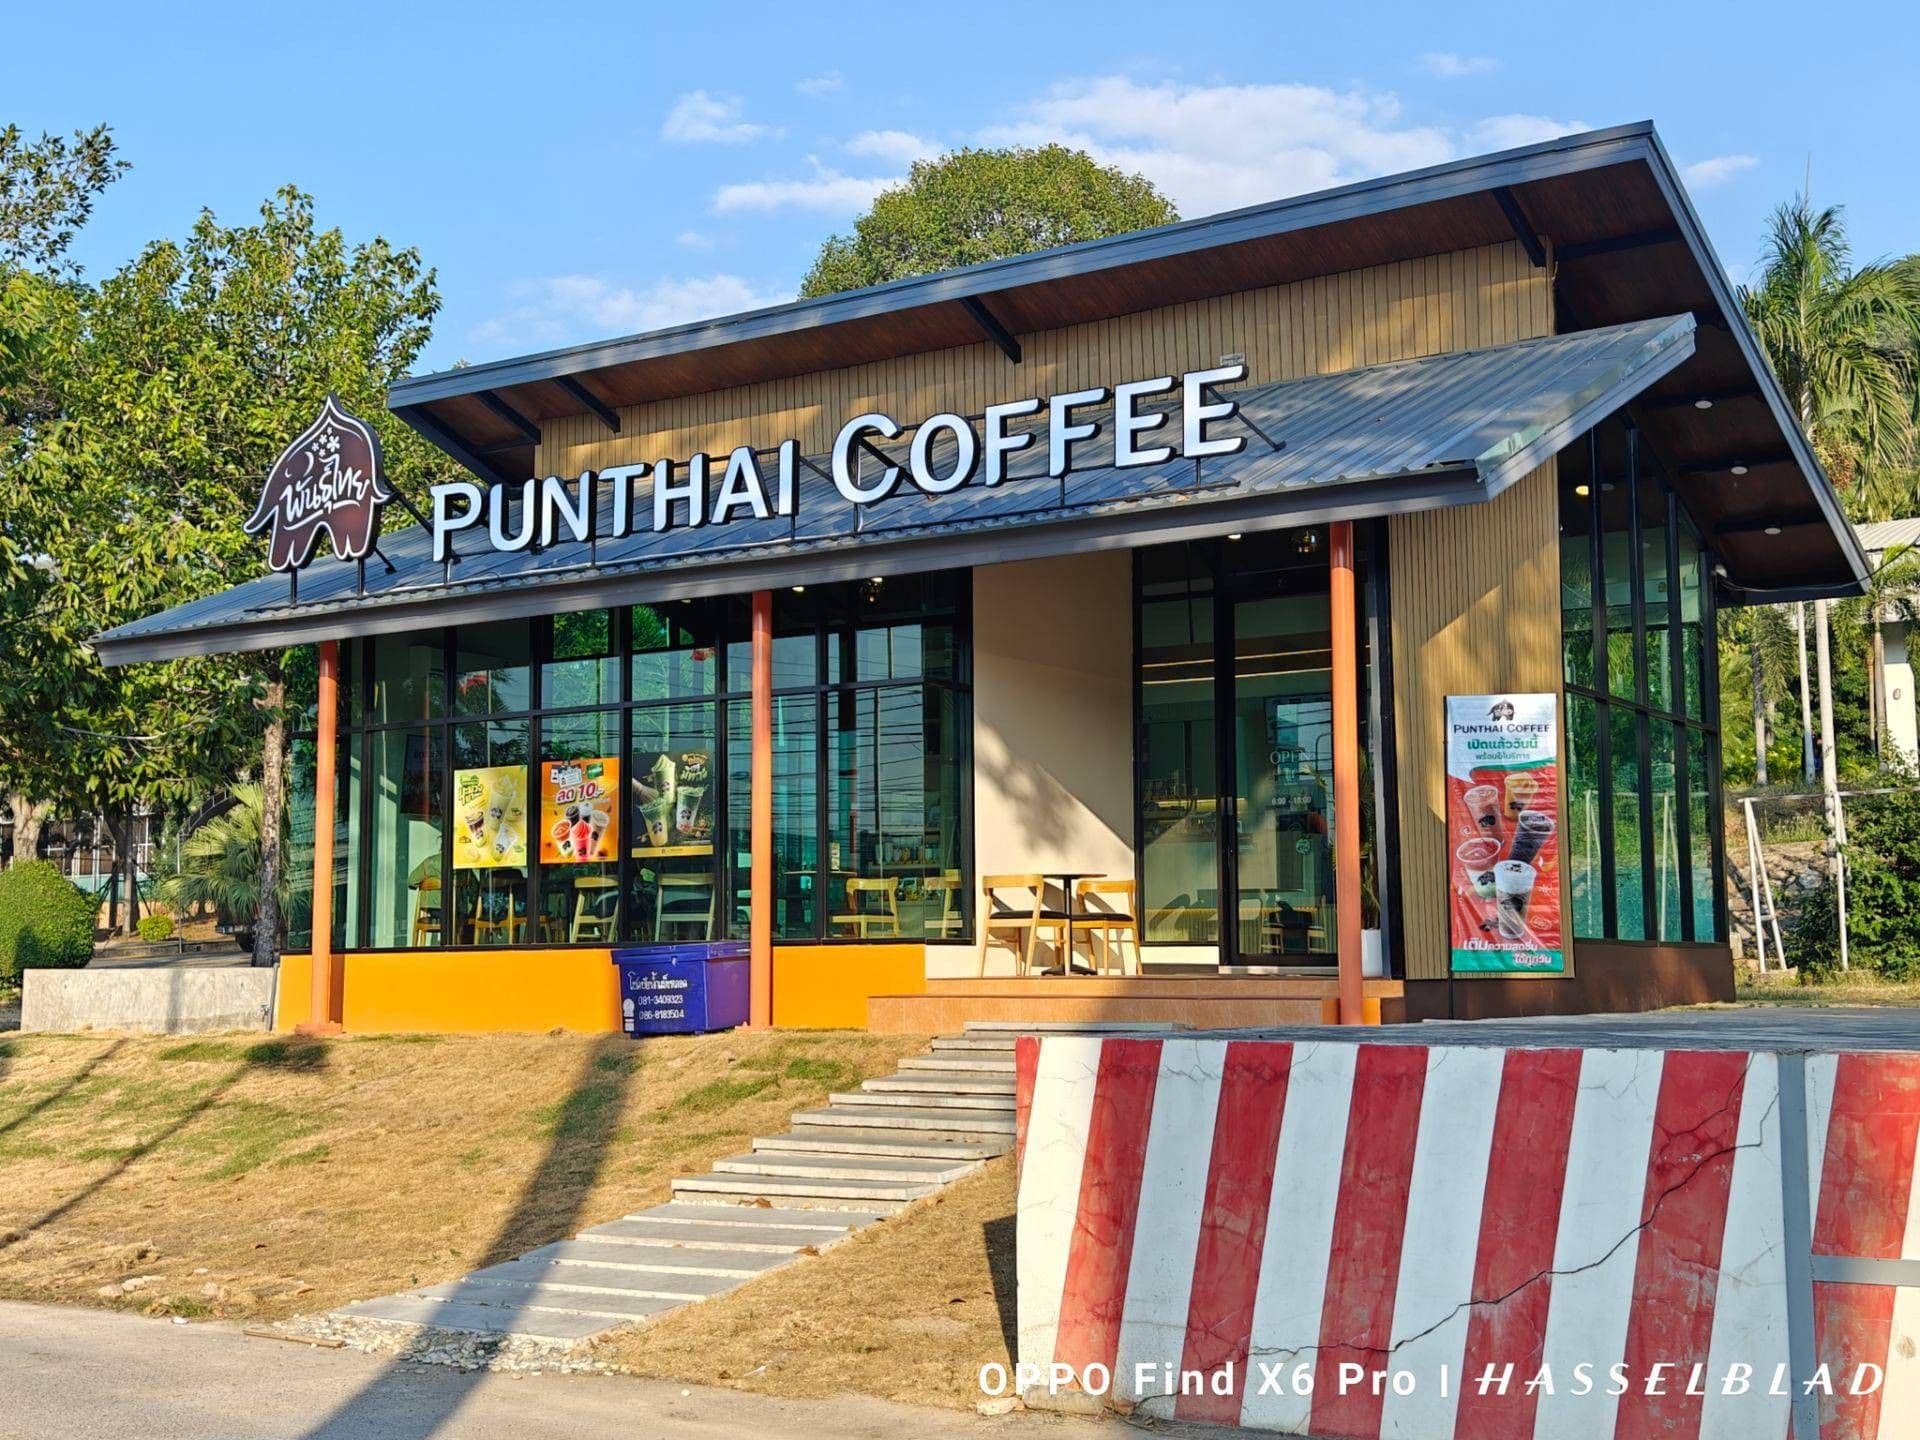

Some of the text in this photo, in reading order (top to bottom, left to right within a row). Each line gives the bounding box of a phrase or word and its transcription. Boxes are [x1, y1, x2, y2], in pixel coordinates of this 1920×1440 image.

[430, 364, 1248, 563] PUNTHAI COFFEE
[1453, 724, 1503, 734] PUNTHAI
[1467, 734, 1539, 750] เปิดแล้ววันนี้
[1270, 750, 1311, 765] OPEN
